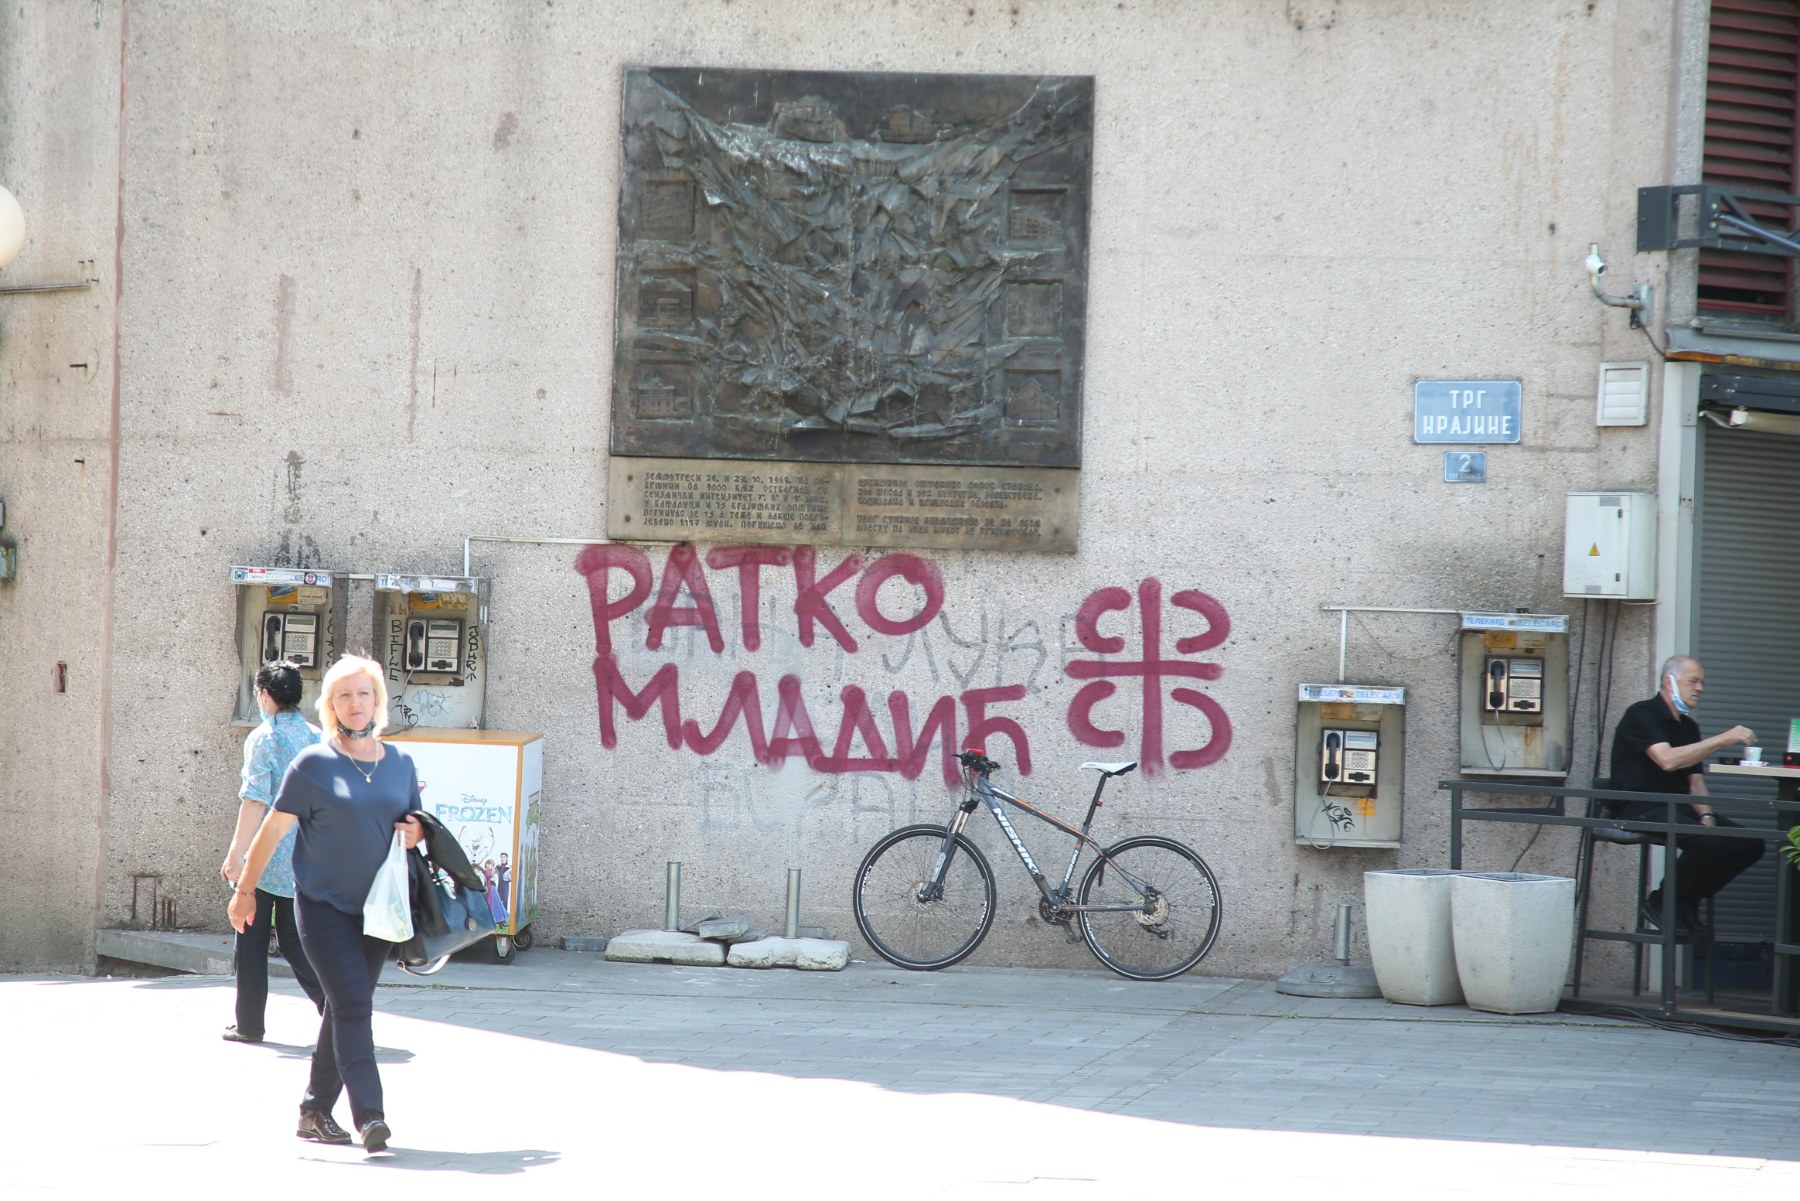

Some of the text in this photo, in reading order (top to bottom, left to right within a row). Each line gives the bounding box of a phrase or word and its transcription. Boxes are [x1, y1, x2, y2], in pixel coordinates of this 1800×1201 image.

[1448, 390, 1487, 409] ТРГ
[1423, 415, 1512, 435] КРАЈИНЕ
[1458, 454, 1472, 472] 2
[574, 542, 945, 654] РАТКО
[1517, 618, 1564, 628] TELECARD
[1355, 689, 1400, 700] TELECARD
[591, 654, 1033, 788] МЛАДИЋ
[460, 793, 488, 805] Disney
[435, 803, 512, 824] FROZEN
